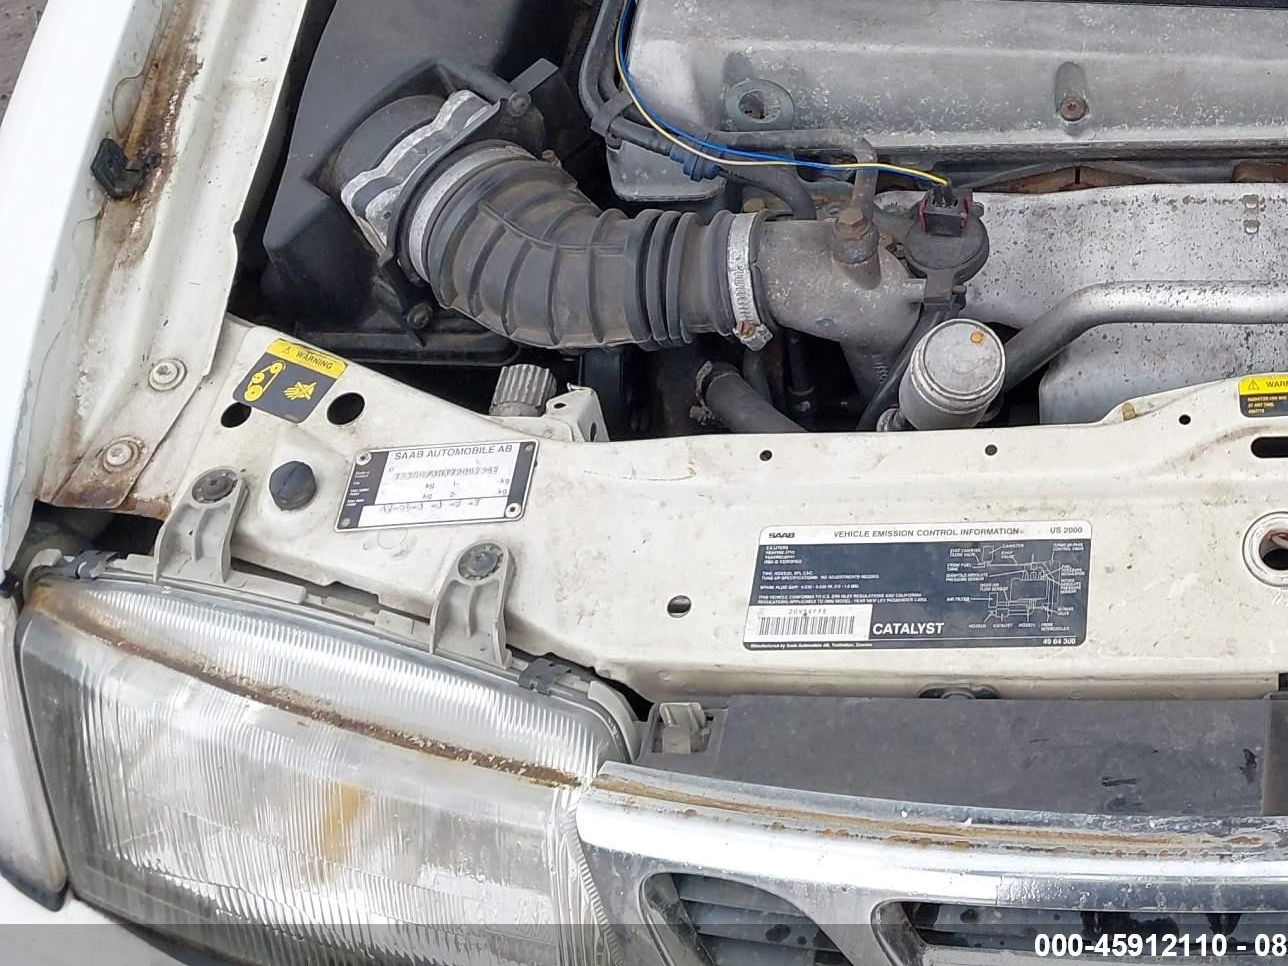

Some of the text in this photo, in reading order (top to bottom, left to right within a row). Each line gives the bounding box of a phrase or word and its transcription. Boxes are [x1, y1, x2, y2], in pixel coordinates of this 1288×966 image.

[296, 350, 334, 370] WARNING
[394, 444, 513, 462] SAAB AUTOMOBILE AB
[834, 527, 1020, 538] VEHICLE EMISSION CONTROL INFORMATION
[1050, 526, 1062, 534] US
[873, 622, 945, 635] CATALYST
